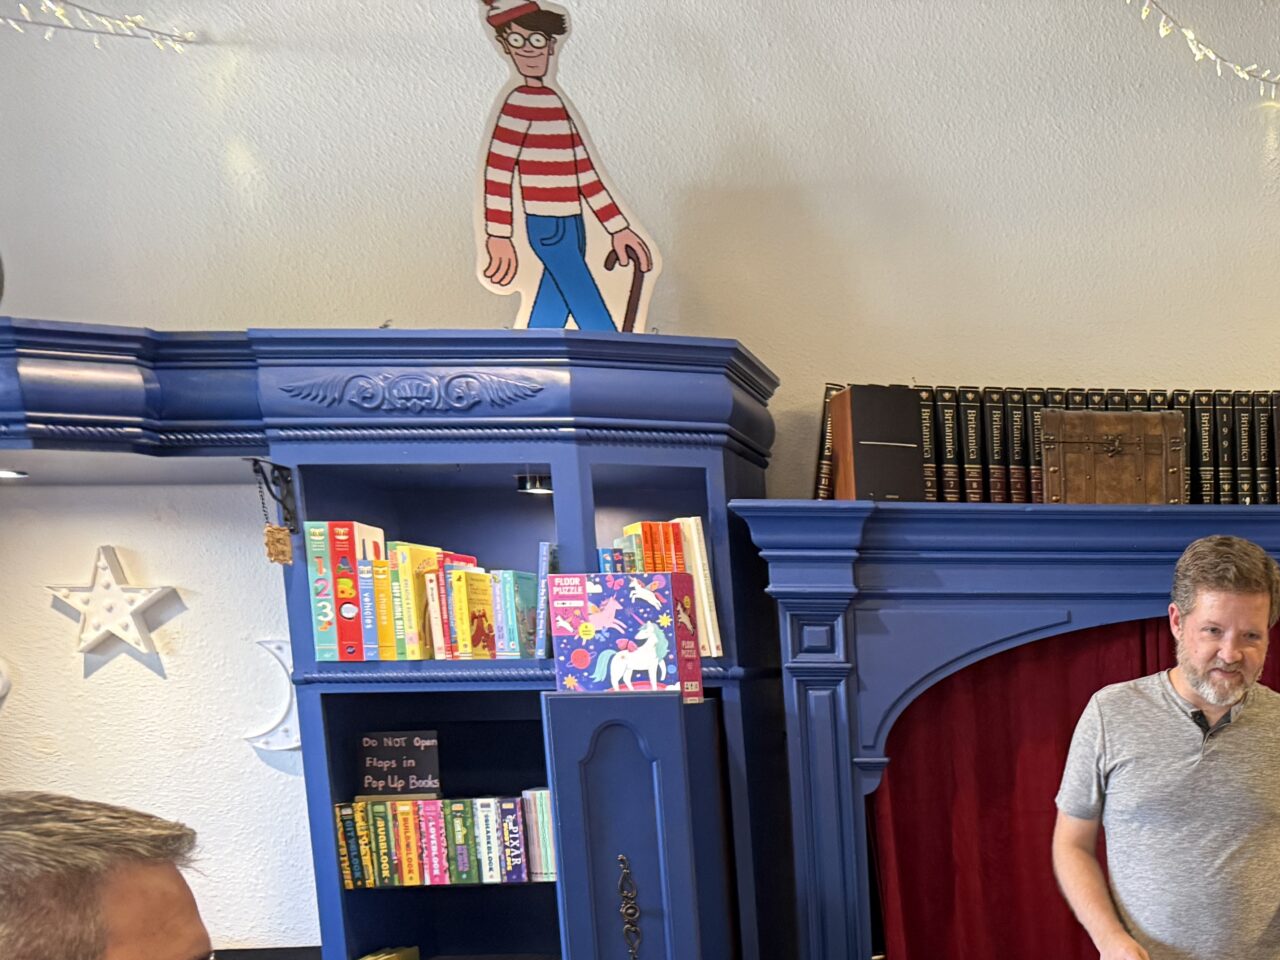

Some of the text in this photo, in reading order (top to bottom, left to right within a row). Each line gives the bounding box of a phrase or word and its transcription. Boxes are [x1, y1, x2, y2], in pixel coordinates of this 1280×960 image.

[921, 408, 931, 458] Britannica
[944, 409, 955, 459] Britannica
[967, 410, 978, 459] Britannica
[992, 410, 1002, 460] Britannica
[1013, 411, 1023, 460] Britannica
[1201, 413, 1211, 461] Britannica
[1241, 413, 1250, 461] Britannica
[1260, 413, 1269, 461] Britannica
[553, 586, 584, 595] PUZZLE
[554, 578, 580, 586] FLOOR
[362, 737, 438, 750] Do NOT Open
[365, 756, 416, 771] Flaps in
[364, 774, 440, 791] Pop Up Books
[509, 826, 522, 866] PIXAR
